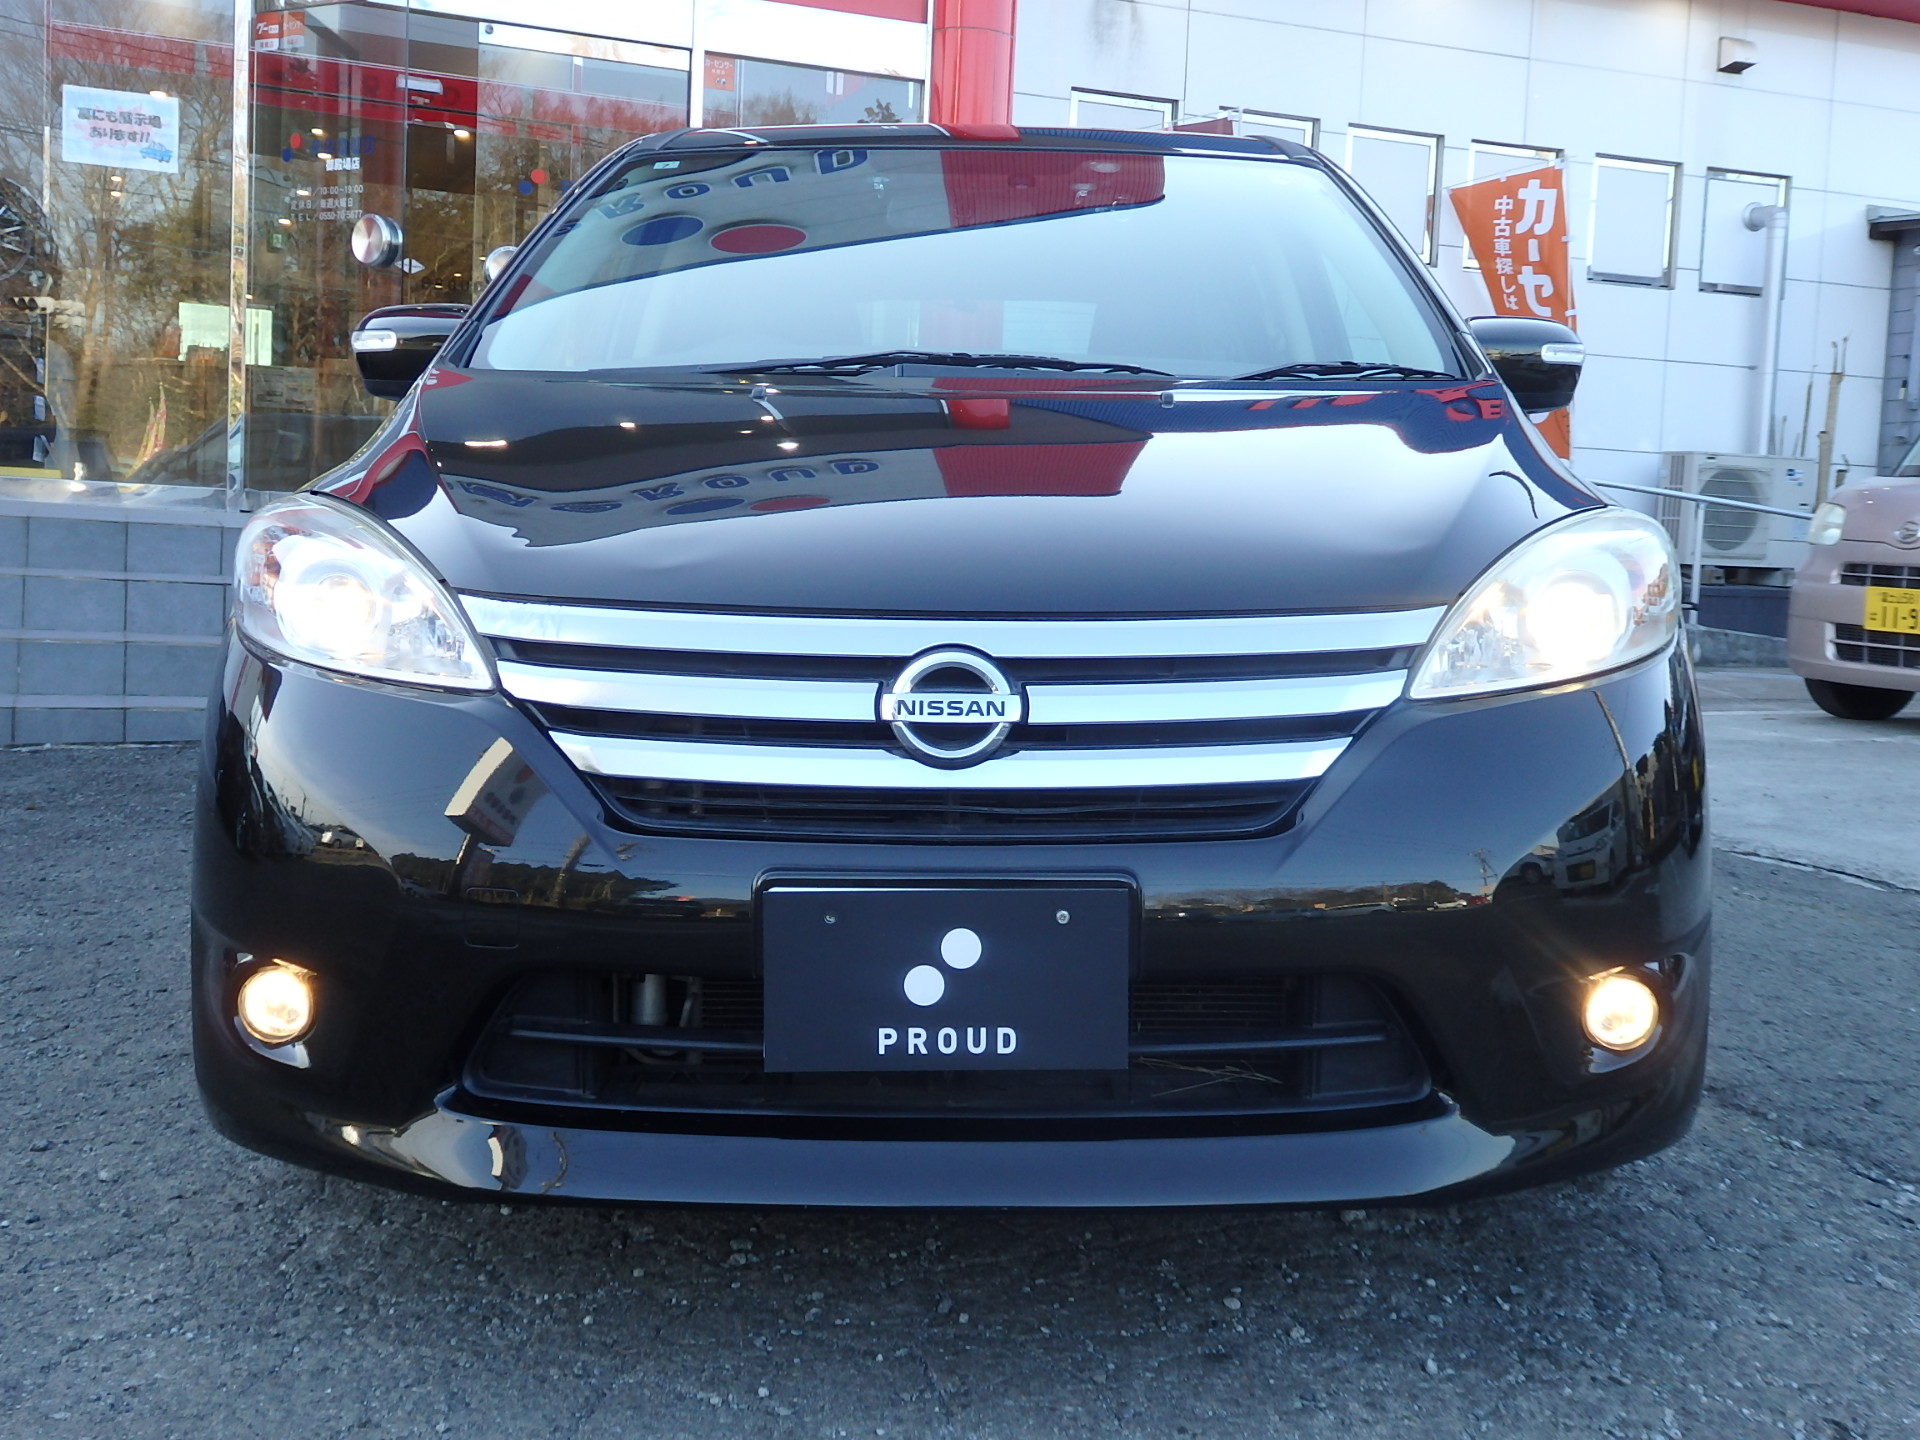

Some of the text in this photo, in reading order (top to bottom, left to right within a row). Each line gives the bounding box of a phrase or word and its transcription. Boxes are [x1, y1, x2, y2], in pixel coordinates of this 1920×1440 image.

[1493, 195, 1519, 310] 中古車探しは
[897, 699, 1005, 717] NISSAN
[878, 1027, 1017, 1055] PROUD
